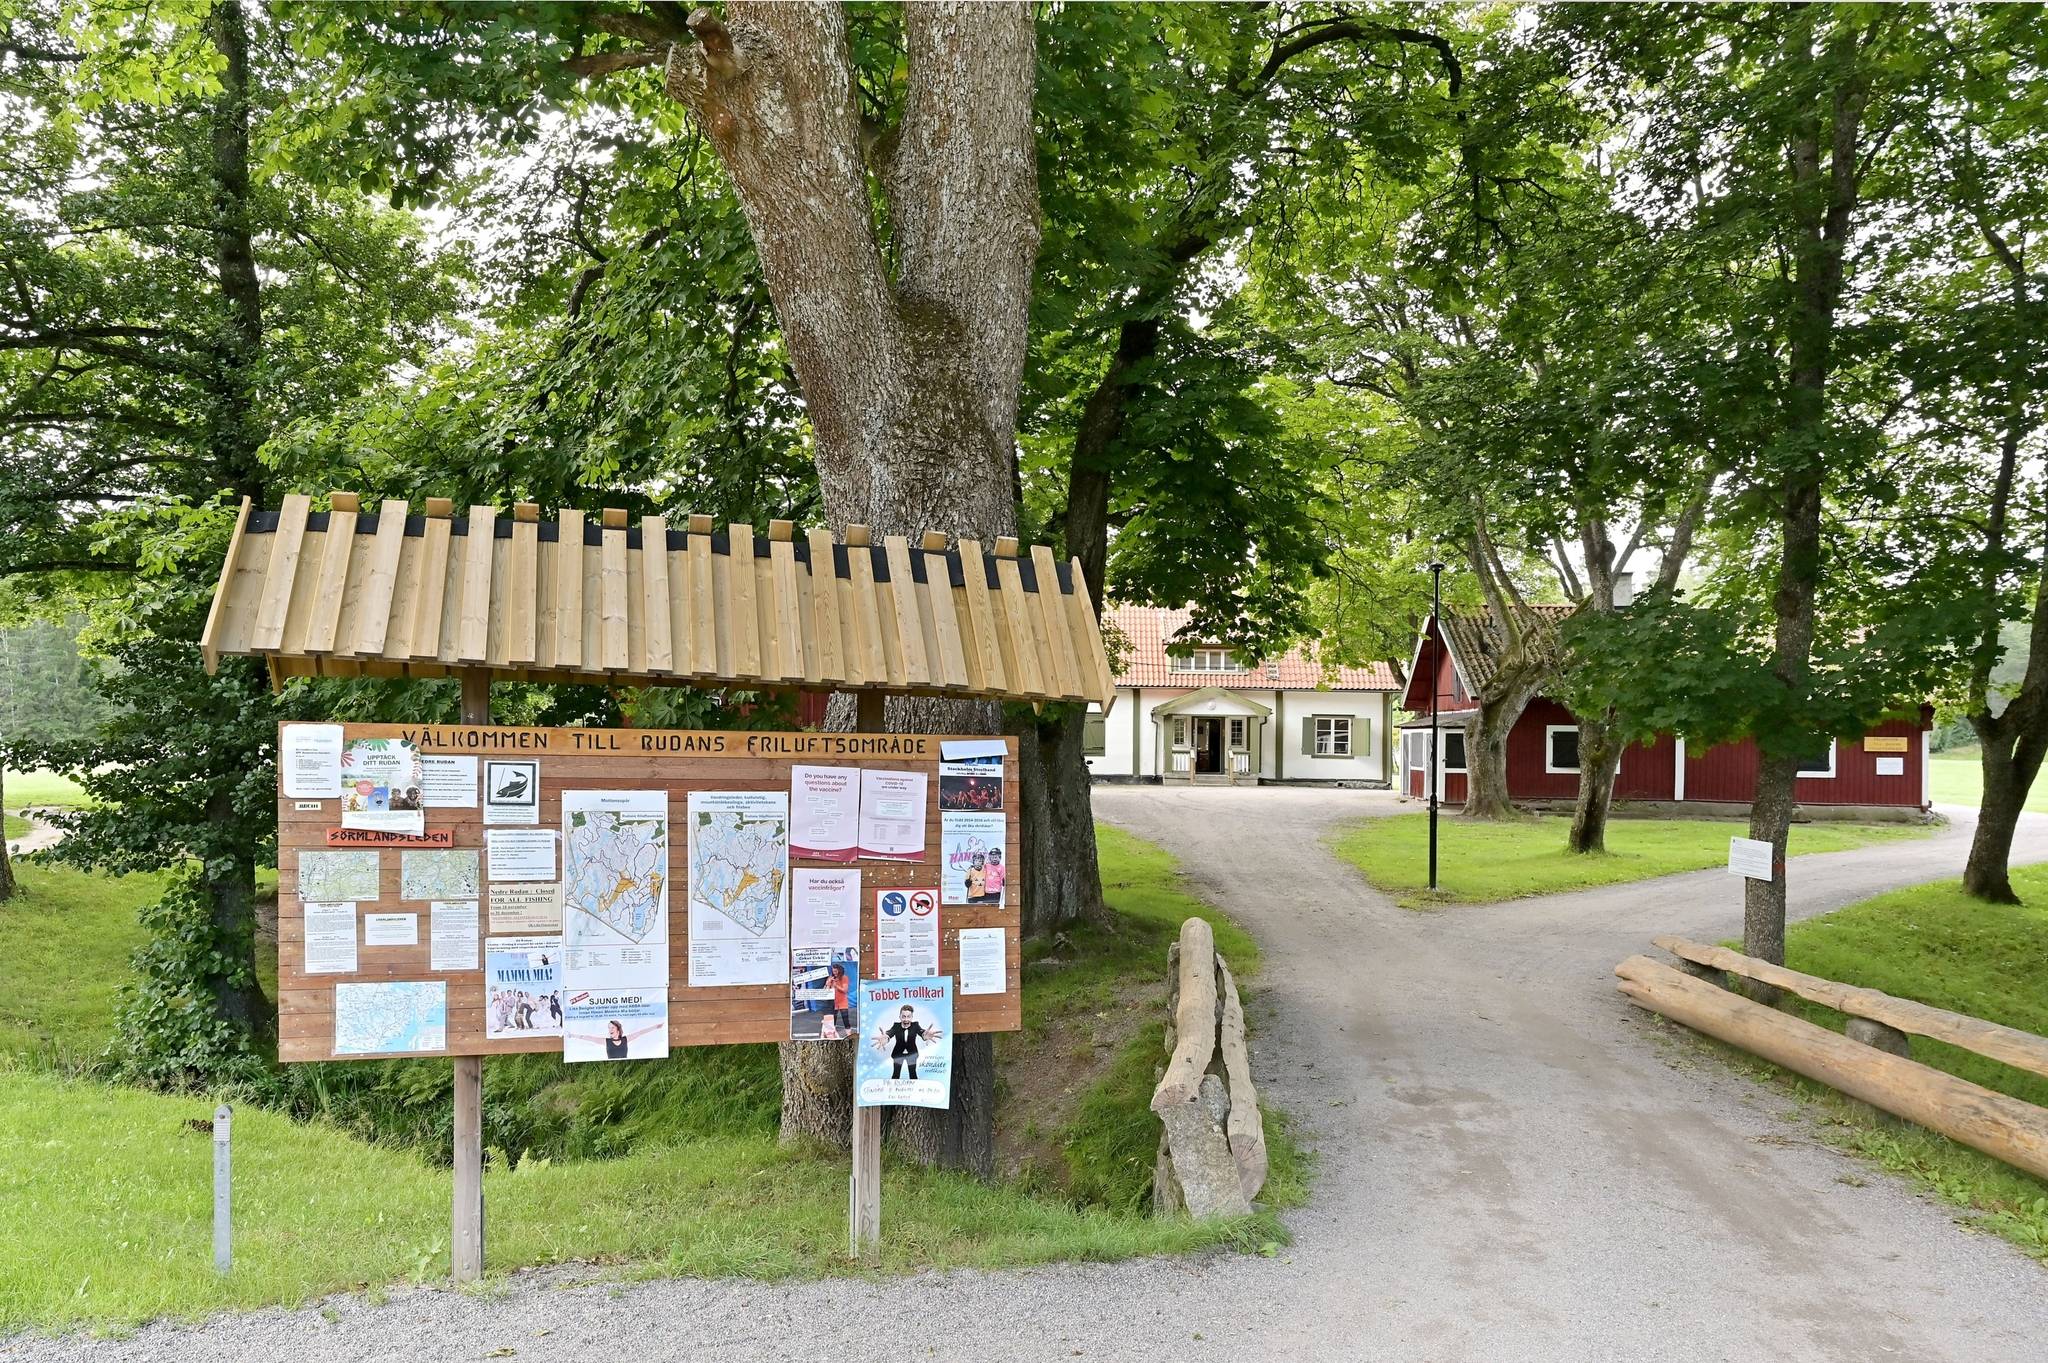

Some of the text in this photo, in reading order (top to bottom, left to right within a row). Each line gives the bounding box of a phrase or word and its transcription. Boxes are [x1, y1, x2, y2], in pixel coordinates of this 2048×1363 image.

[402, 727, 927, 754] VÄLKOMMEN TILL RUDANS FRILUFTSOMRÅDE
[330, 830, 449, 842] SÖRMLANDSLEDEN
[496, 967, 553, 982] MAMMA MIA!
[589, 997, 619, 1006] SJUNG
[620, 996, 643, 1004] MED!
[868, 986, 945, 1002] Tobbe Trollkarl
